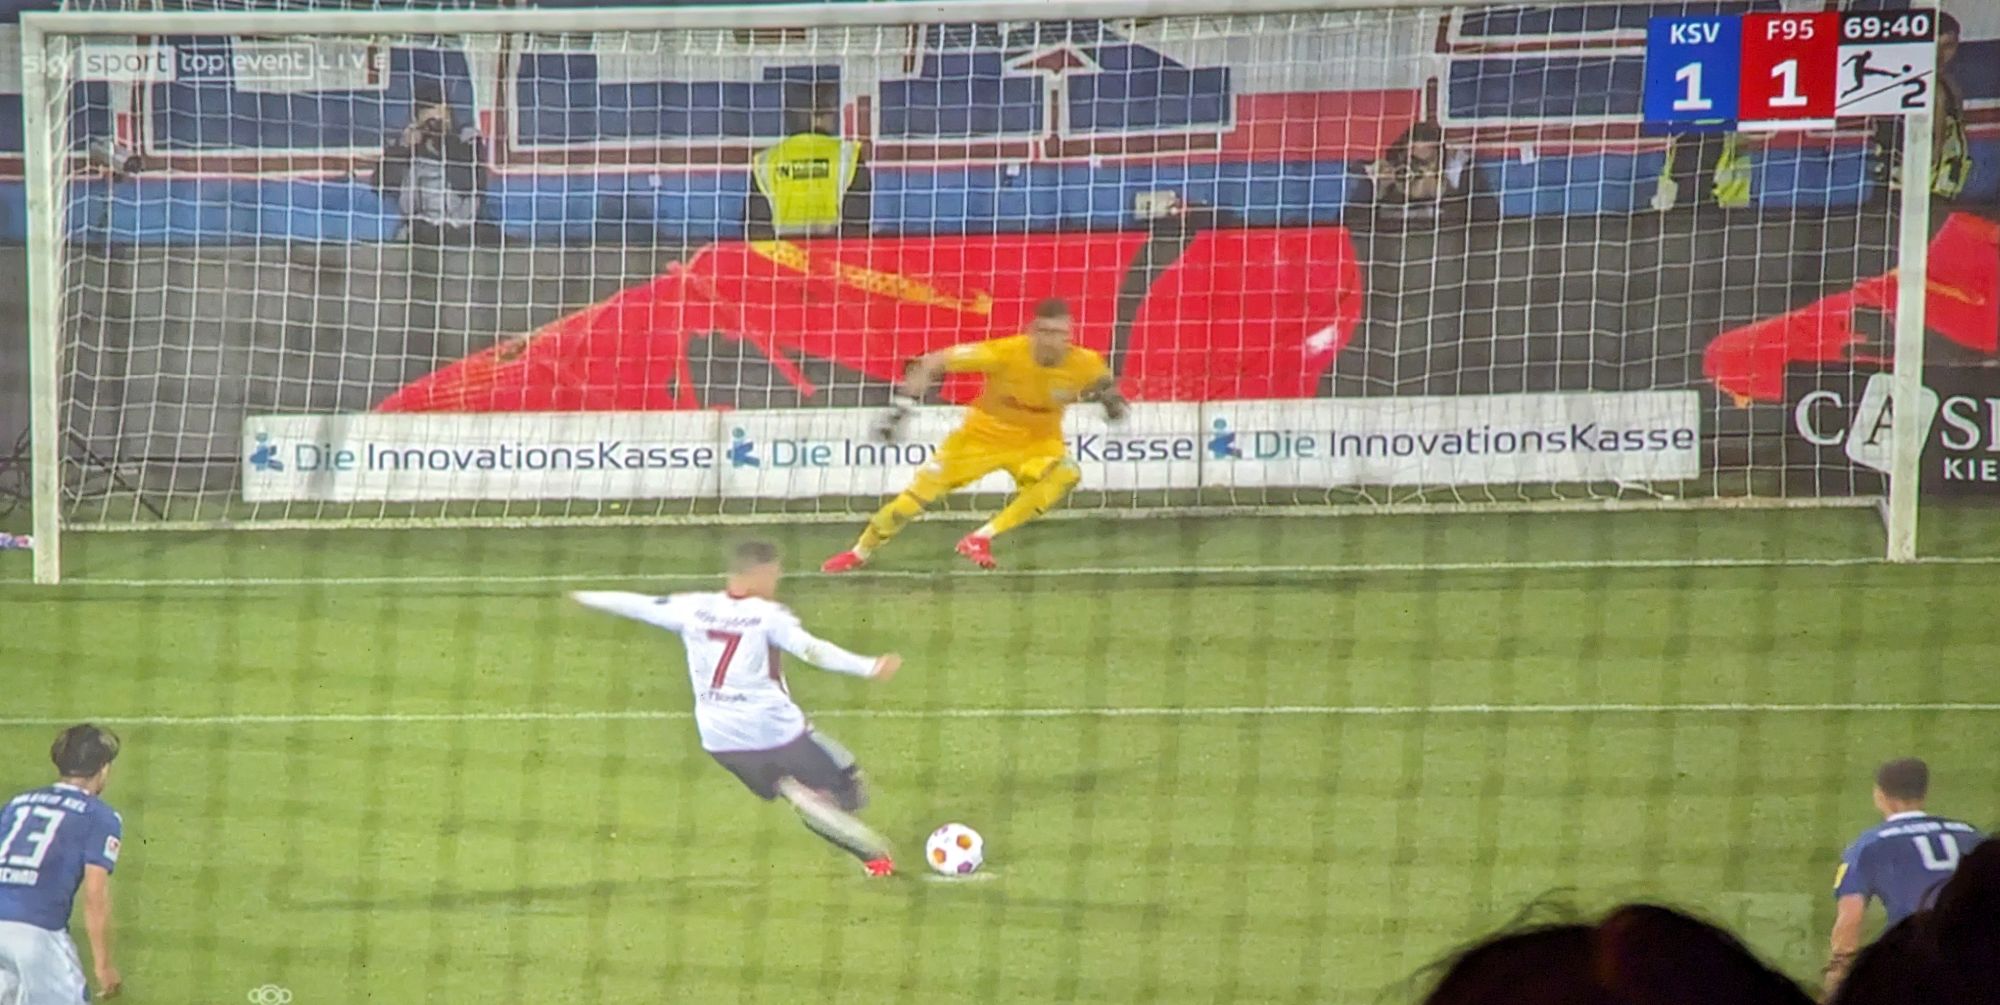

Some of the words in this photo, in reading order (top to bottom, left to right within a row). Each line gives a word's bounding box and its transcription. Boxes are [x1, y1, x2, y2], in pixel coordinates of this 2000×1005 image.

[1670, 22, 1720, 44] KSV
[1766, 19, 1815, 41] F95
[1844, 14, 1930, 39] 69:40
[87, 51, 169, 77] sport
[180, 53, 226, 75] top
[232, 52, 304, 72] event
[319, 53, 386, 70] LIVE
[1673, 62, 1713, 111] 1
[1768, 59, 1808, 107] 1
[1900, 78, 1927, 109] 2
[294, 442, 356, 473] Die
[368, 440, 714, 472] InnovationsKasse
[772, 438, 831, 467] Die
[1254, 429, 1315, 459] Die
[1329, 422, 1695, 457] InnovationsKasse
[706, 629, 743, 689] 7
[0, 805, 66, 869] 13
